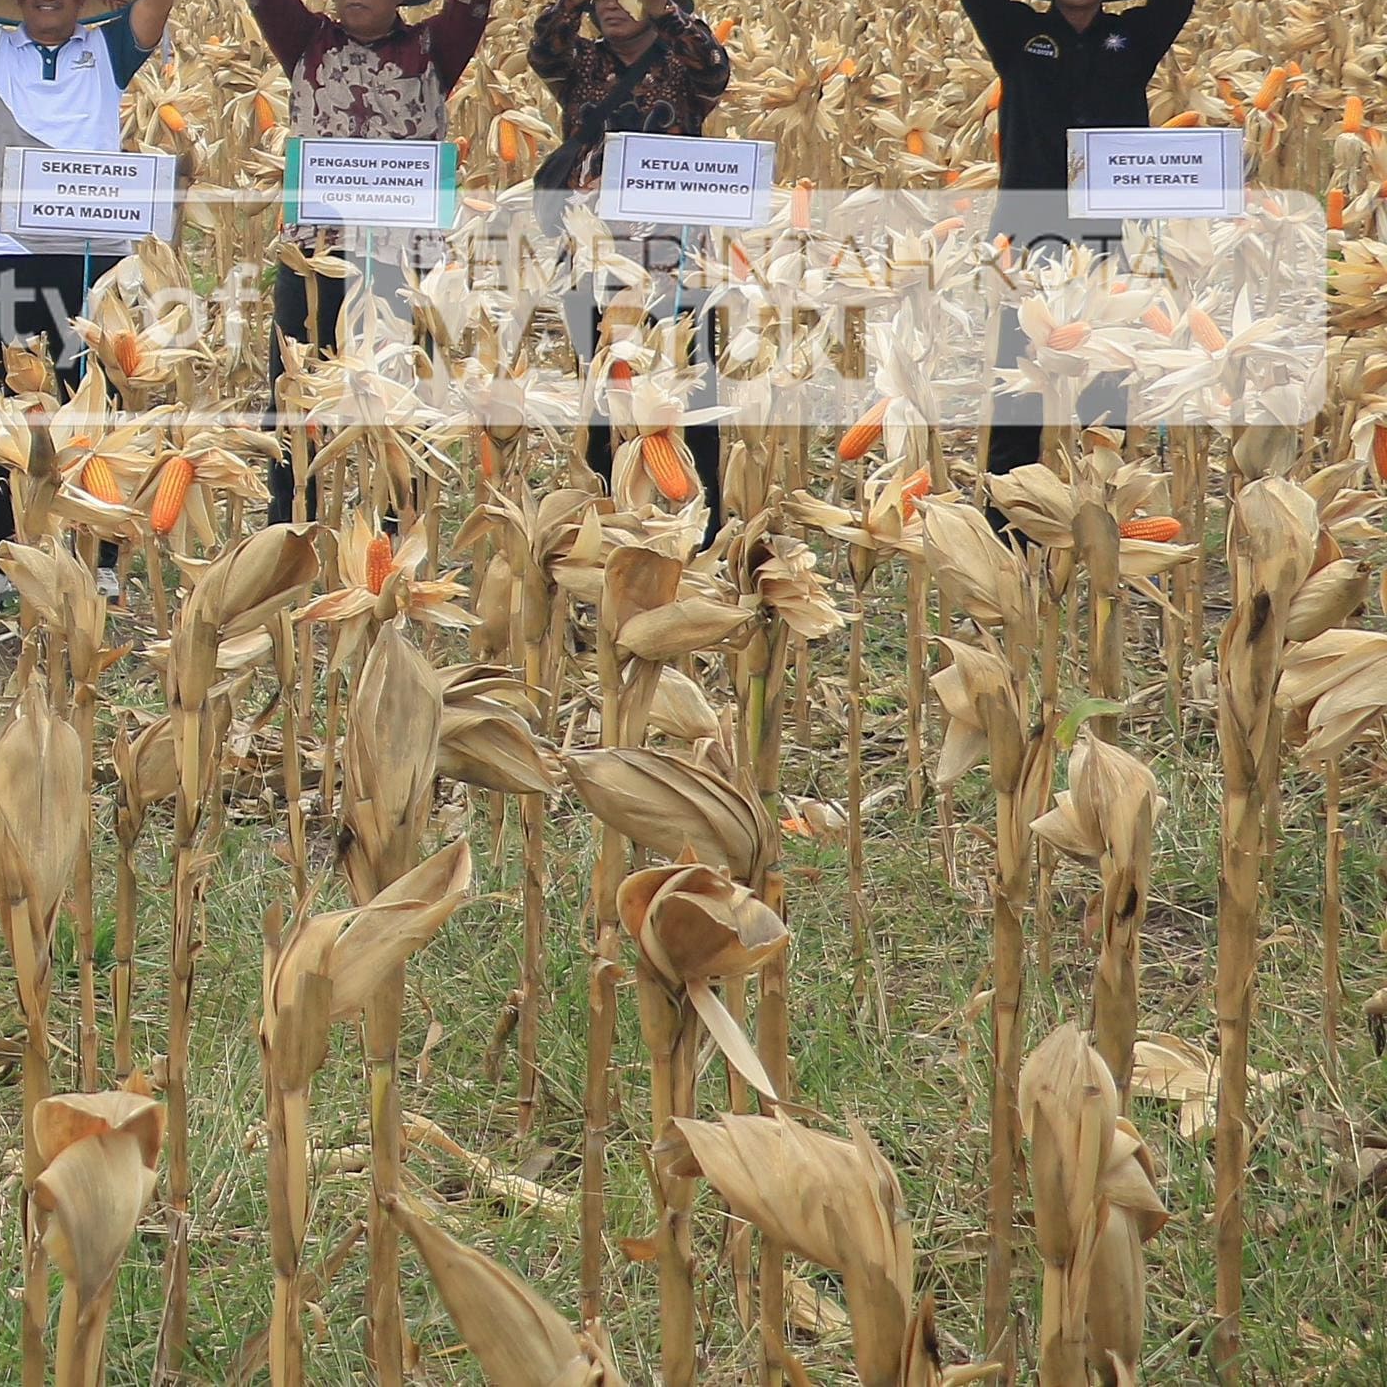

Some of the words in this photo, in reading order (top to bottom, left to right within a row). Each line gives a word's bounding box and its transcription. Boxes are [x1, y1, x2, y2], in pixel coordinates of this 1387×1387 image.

[310, 158, 377, 168] PENGASUH
[381, 160, 429, 169] PONPES
[641, 159, 689, 171] KETUA
[695, 162, 738, 173] UMUM
[1109, 156, 1155, 165] KETUA
[1160, 155, 1202, 164] UMUM
[42, 162, 137, 176] SEKRETARIS
[316, 176, 369, 185] RIYADUL
[372, 177, 423, 186] JANNAH
[1113, 175, 1140, 184] PSH
[1145, 175, 1198, 184] TERATE
[58, 184, 119, 197] DAERAH
[627, 179, 676, 190] PSHTM
[680, 182, 749, 194] WINONGO
[321, 193, 350, 207] (GUS
[354, 193, 415, 207] MAMANG)
[33, 205, 74, 217] KOTA
[80, 208, 140, 220] MADIUN
